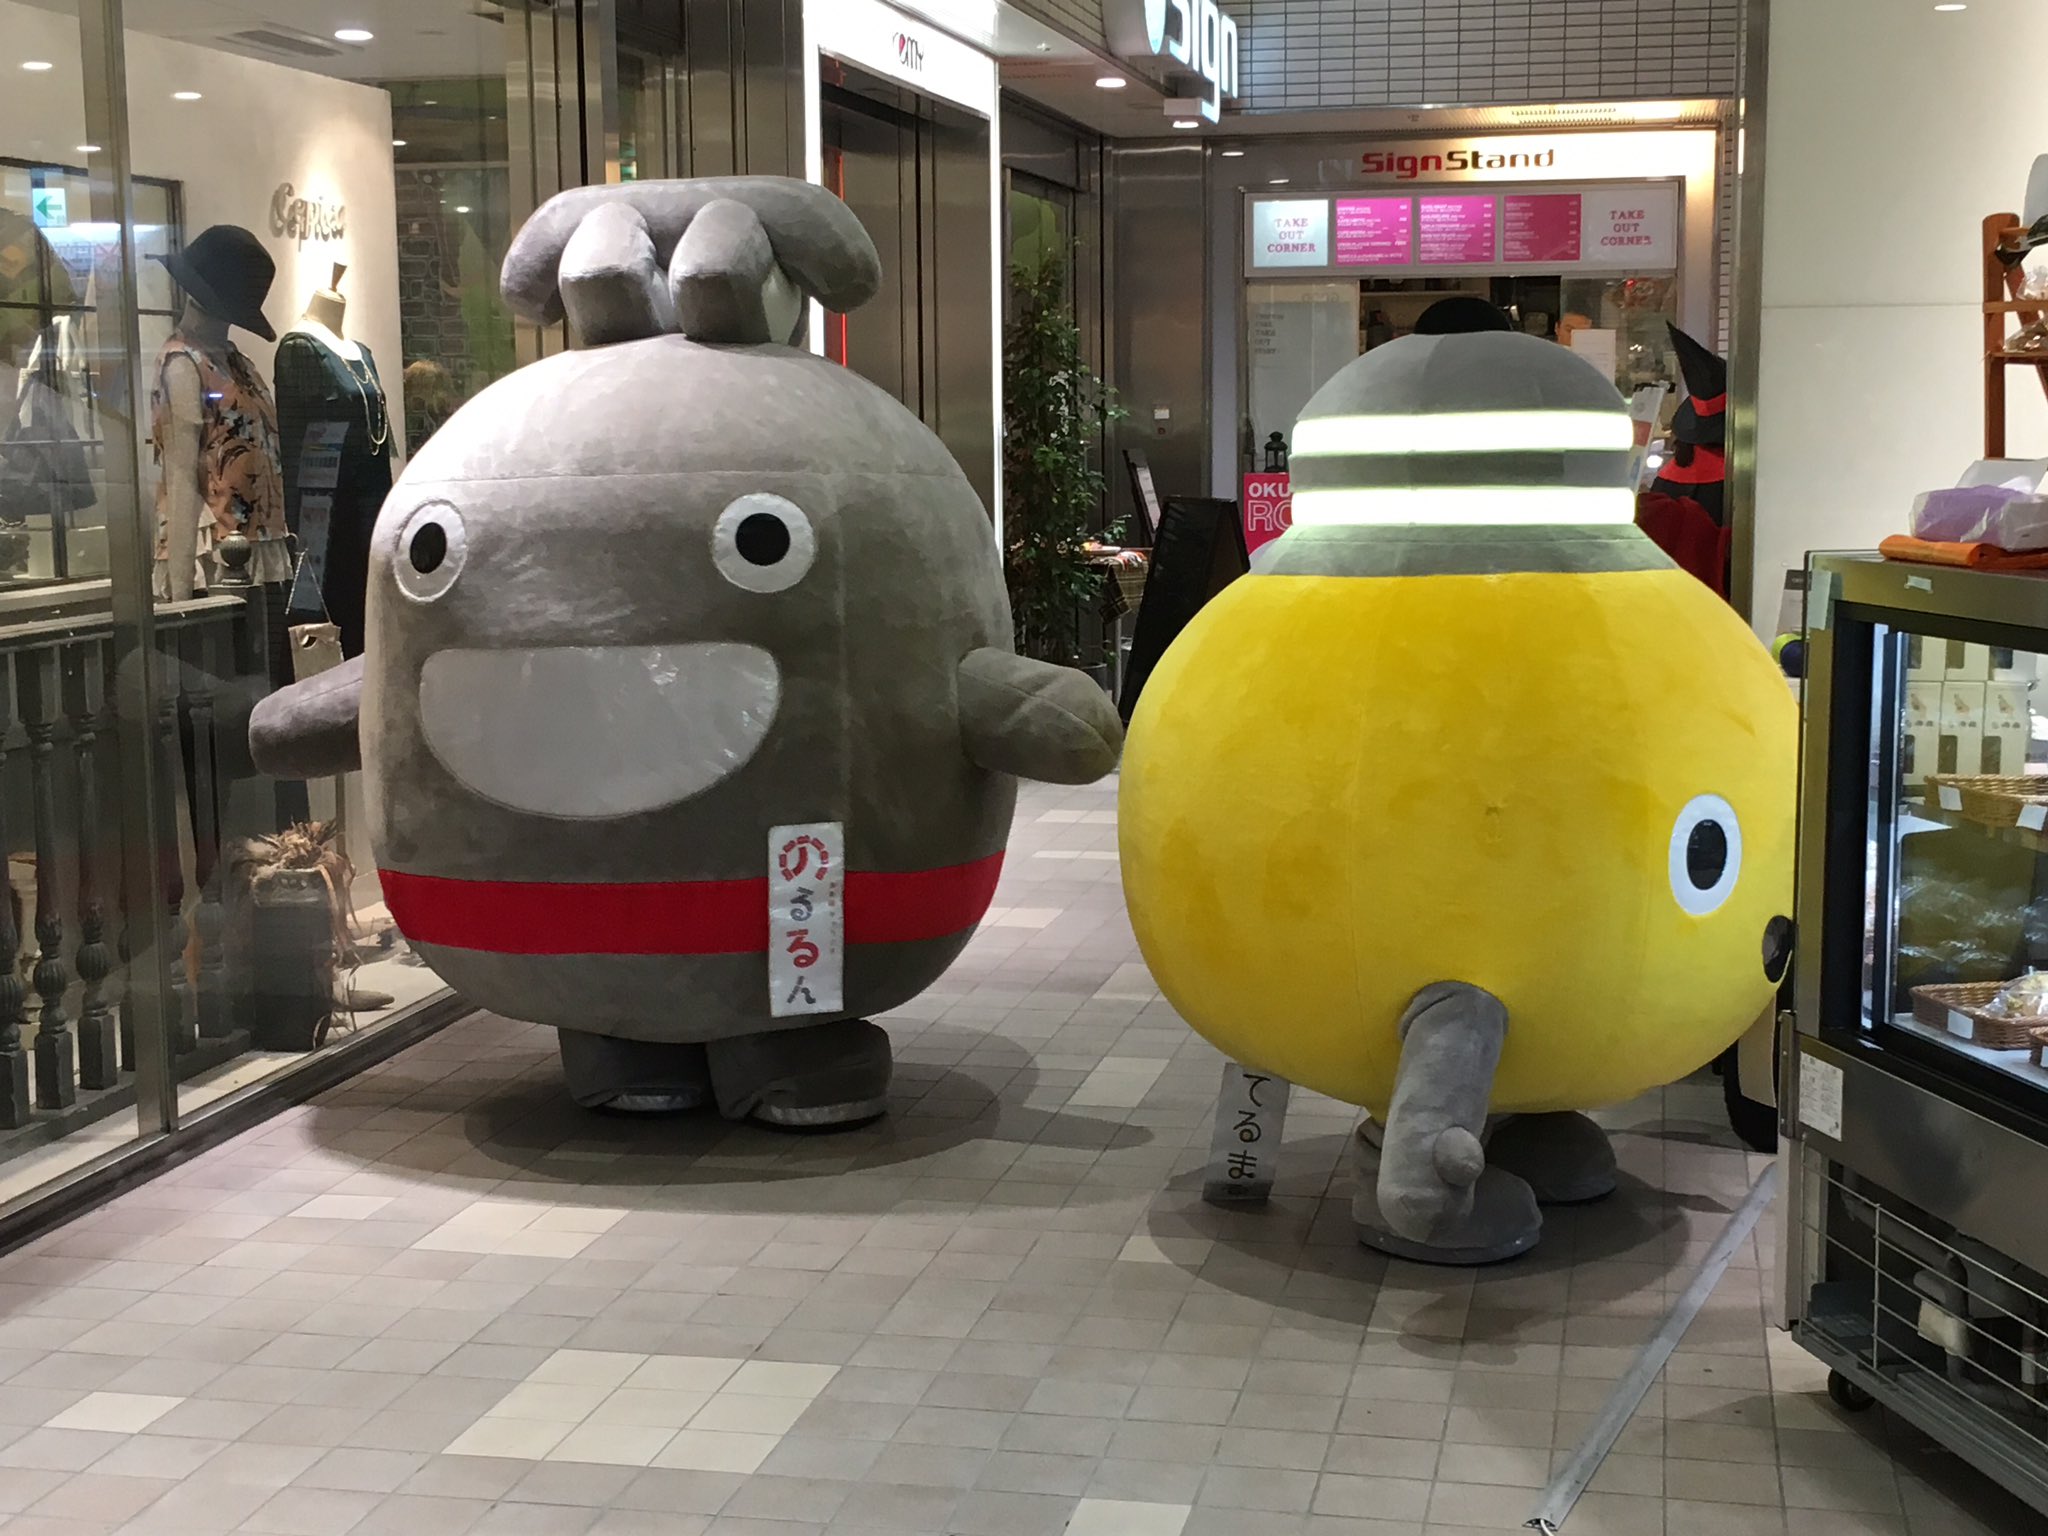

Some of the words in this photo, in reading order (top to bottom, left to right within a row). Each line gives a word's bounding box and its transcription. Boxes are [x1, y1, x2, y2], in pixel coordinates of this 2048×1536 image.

[1361, 149, 1554, 179] SignStand
[1609, 209, 1645, 220] TAKE
[1274, 218, 1309, 228] TAKE
[1613, 223, 1640, 233] OUT
[1279, 230, 1304, 240] OUT
[1600, 235, 1653, 246] CORNER
[1267, 243, 1316, 253] CORNER
[778, 834, 829, 1004] のるるん
